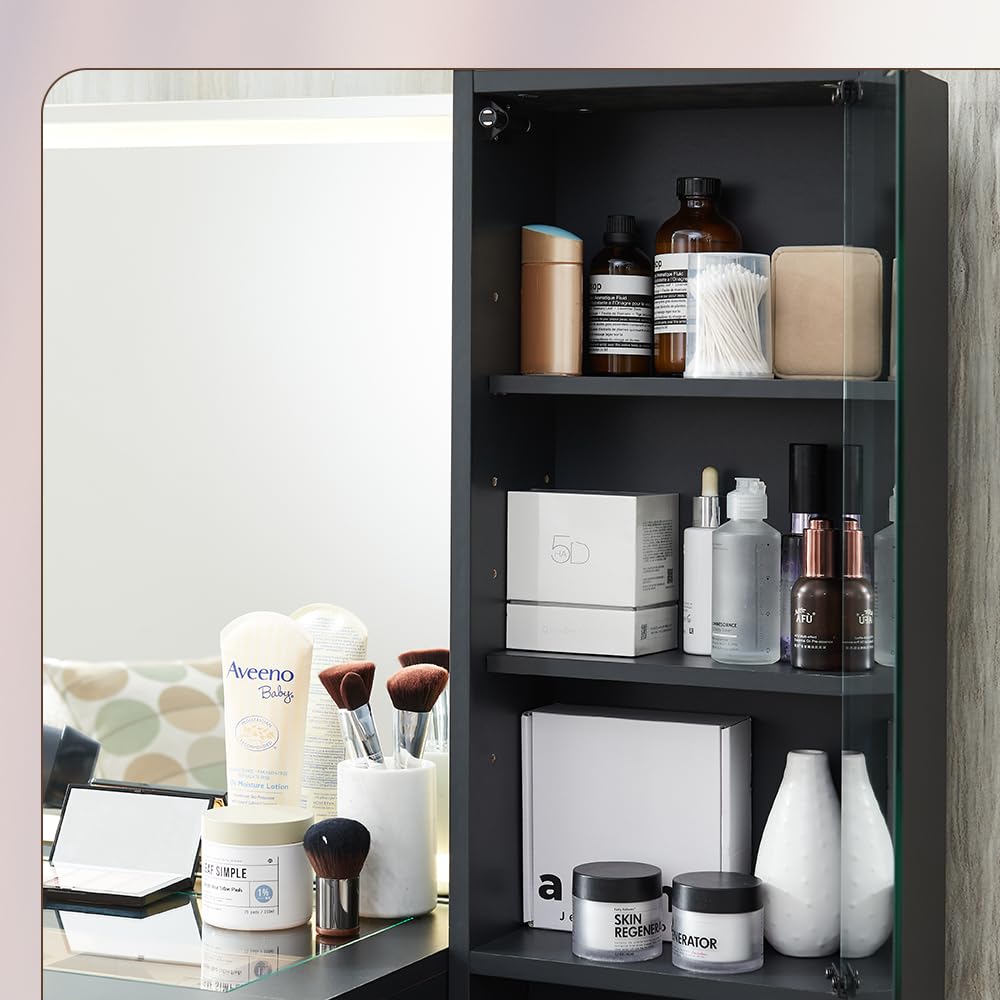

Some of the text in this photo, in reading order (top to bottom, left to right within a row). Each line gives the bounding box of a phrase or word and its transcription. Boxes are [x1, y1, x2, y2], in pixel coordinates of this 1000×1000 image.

[227, 660, 294, 682] Aveeno
[215, 865, 247, 879] SIMPLE
[614, 913, 642, 926] SKIN
